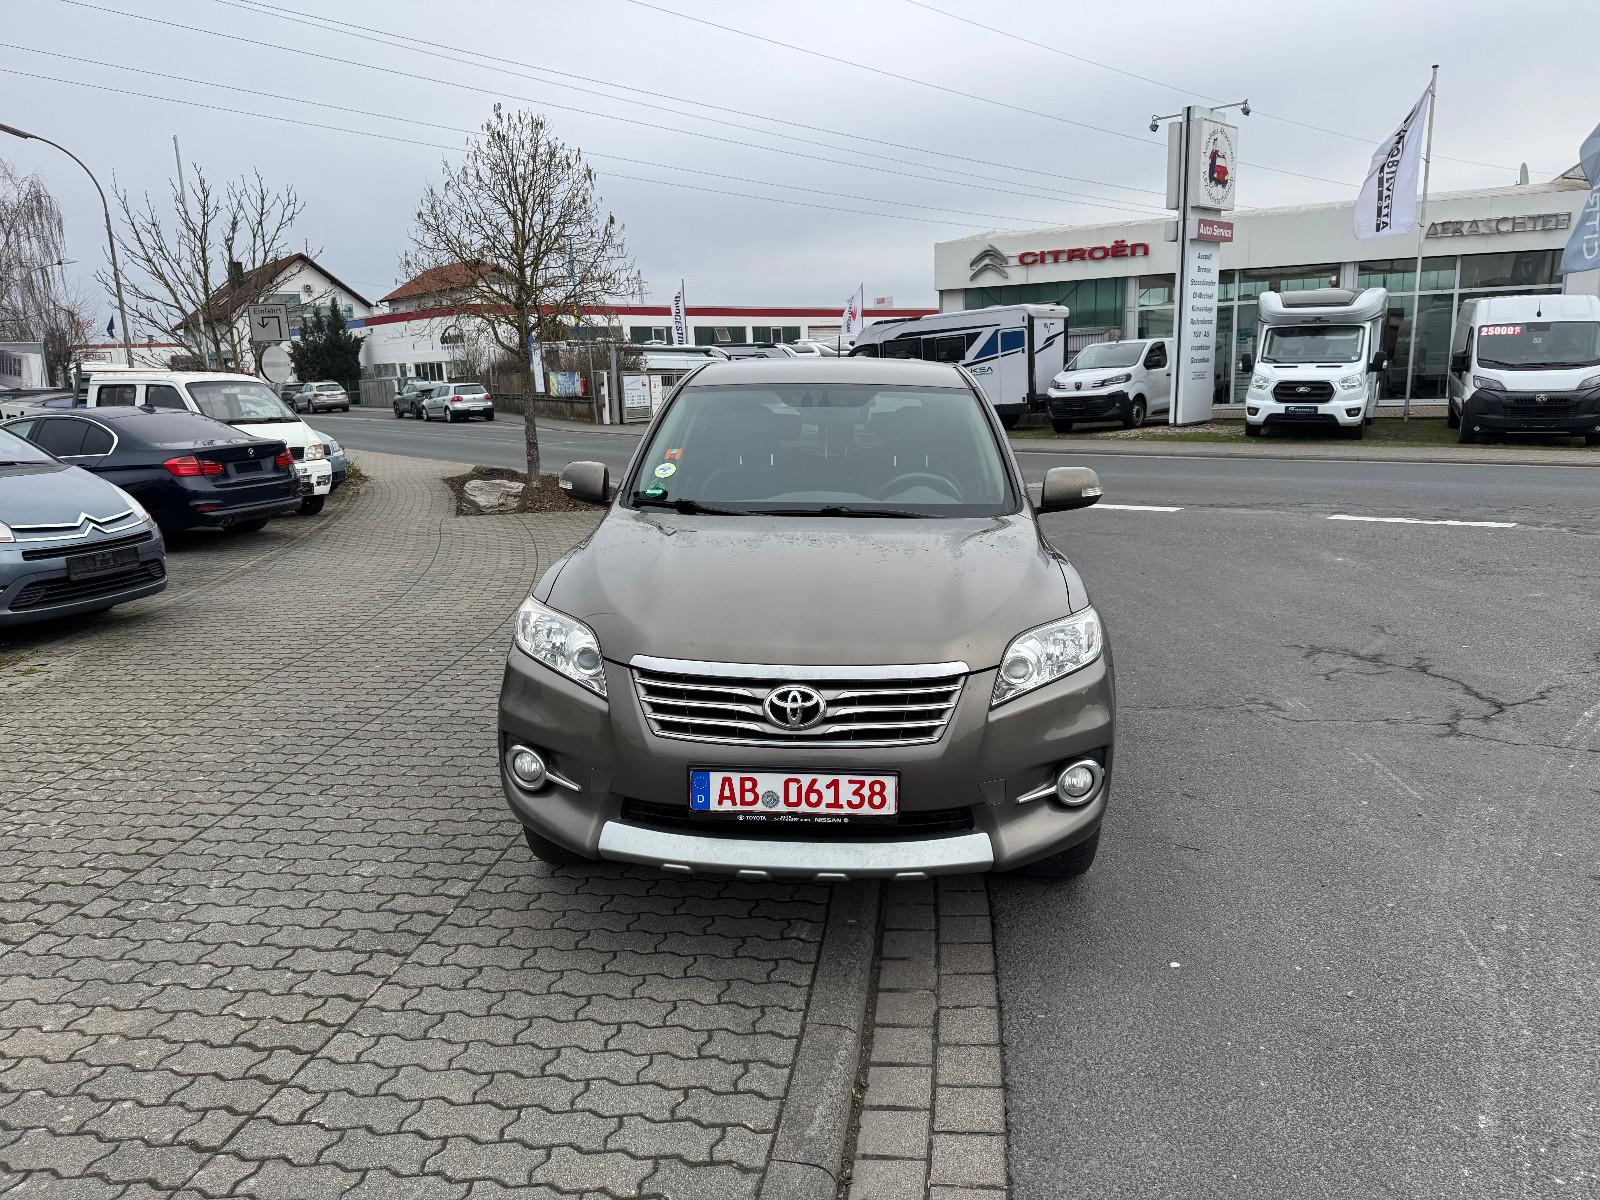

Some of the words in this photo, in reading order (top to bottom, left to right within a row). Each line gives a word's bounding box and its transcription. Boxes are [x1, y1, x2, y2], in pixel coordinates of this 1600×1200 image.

[1199, 222, 1213, 236] Auto
[1213, 224, 1233, 239] Service
[253, 307, 282, 315] Einfahrt
[697, 793, 705, 804] D
[717, 776, 760, 808] AB
[783, 777, 887, 811] 06138
